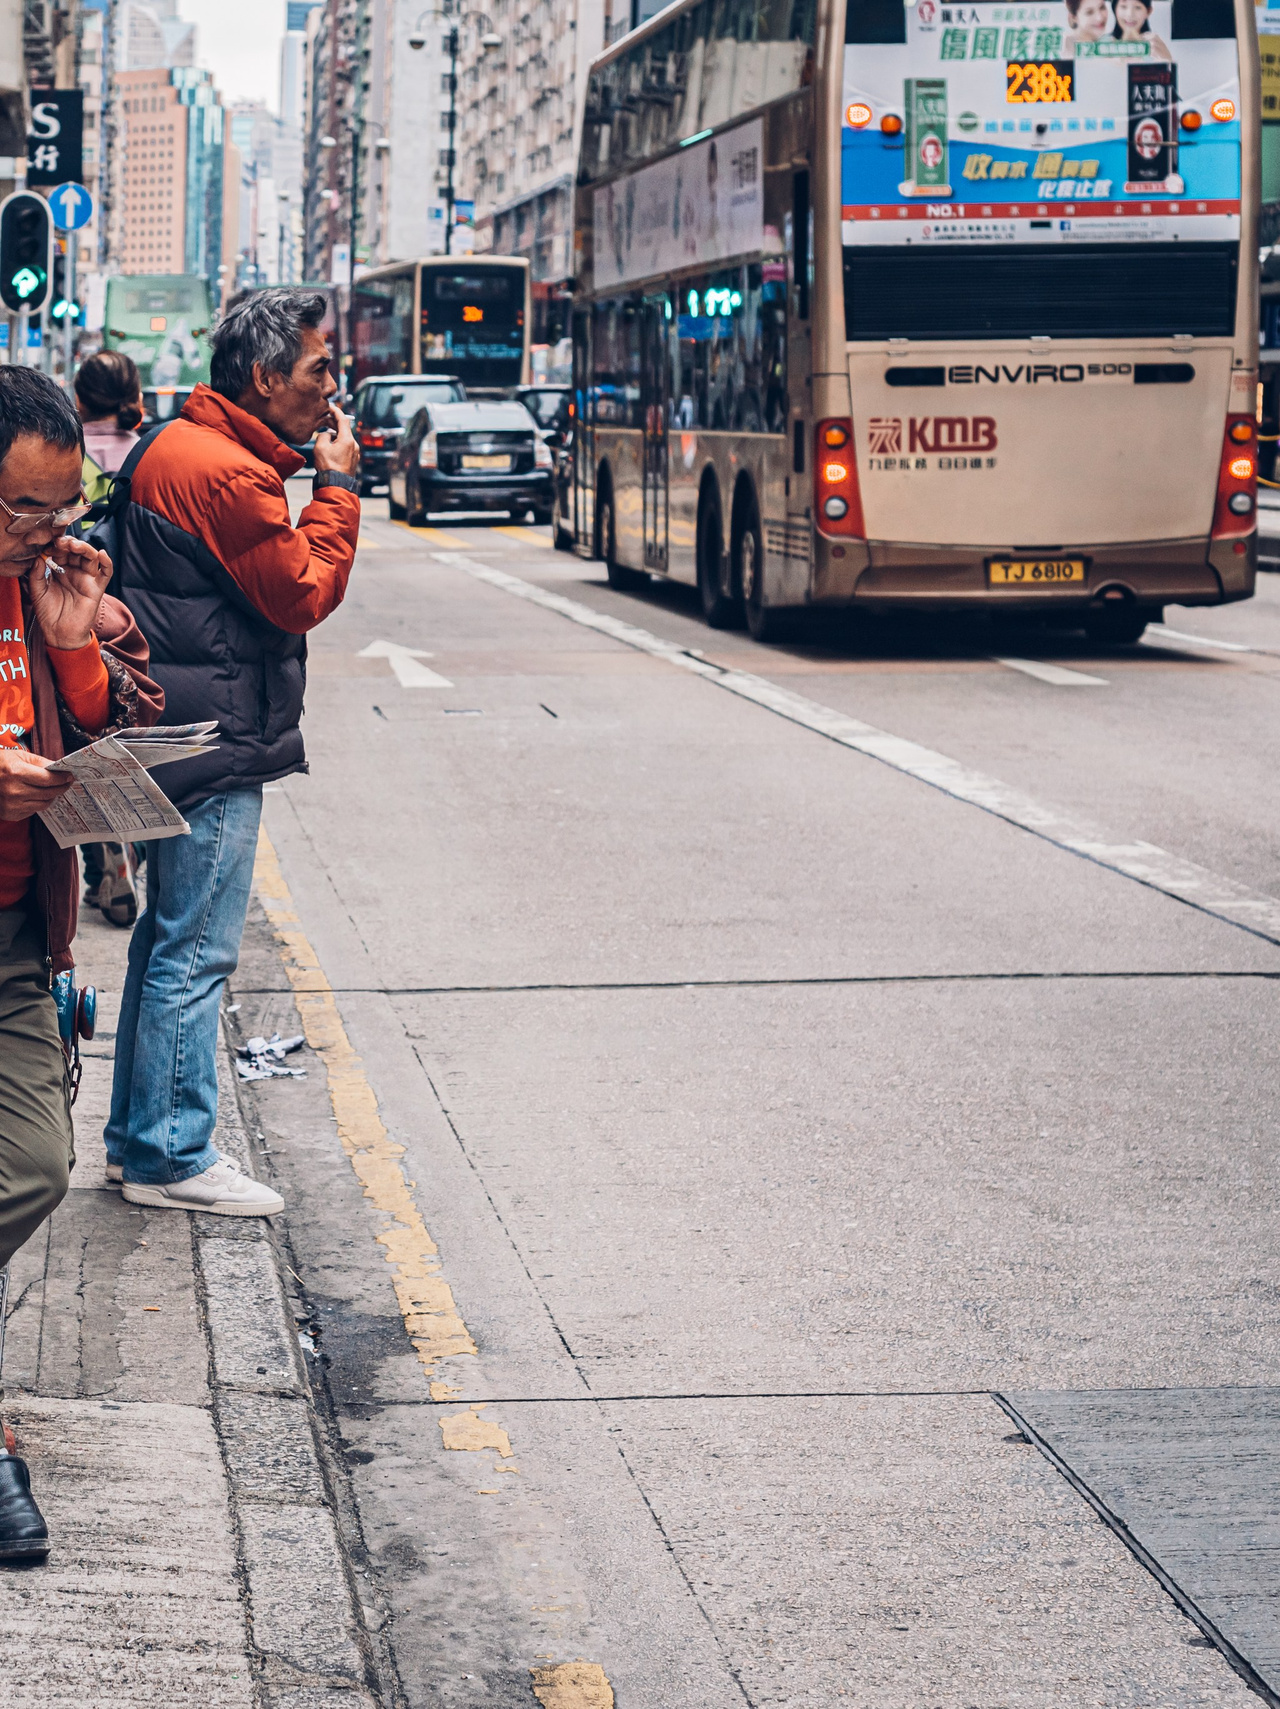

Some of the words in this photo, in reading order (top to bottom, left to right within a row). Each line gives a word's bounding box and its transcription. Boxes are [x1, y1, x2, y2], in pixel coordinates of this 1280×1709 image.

[1006, 63, 1071, 103] 238x
[949, 364, 1085, 384] ENVIRO
[1087, 363, 1132, 376] 500
[909, 416, 999, 453] KMB
[1001, 564, 1026, 580] TJ
[1032, 562, 1074, 579] 6810
